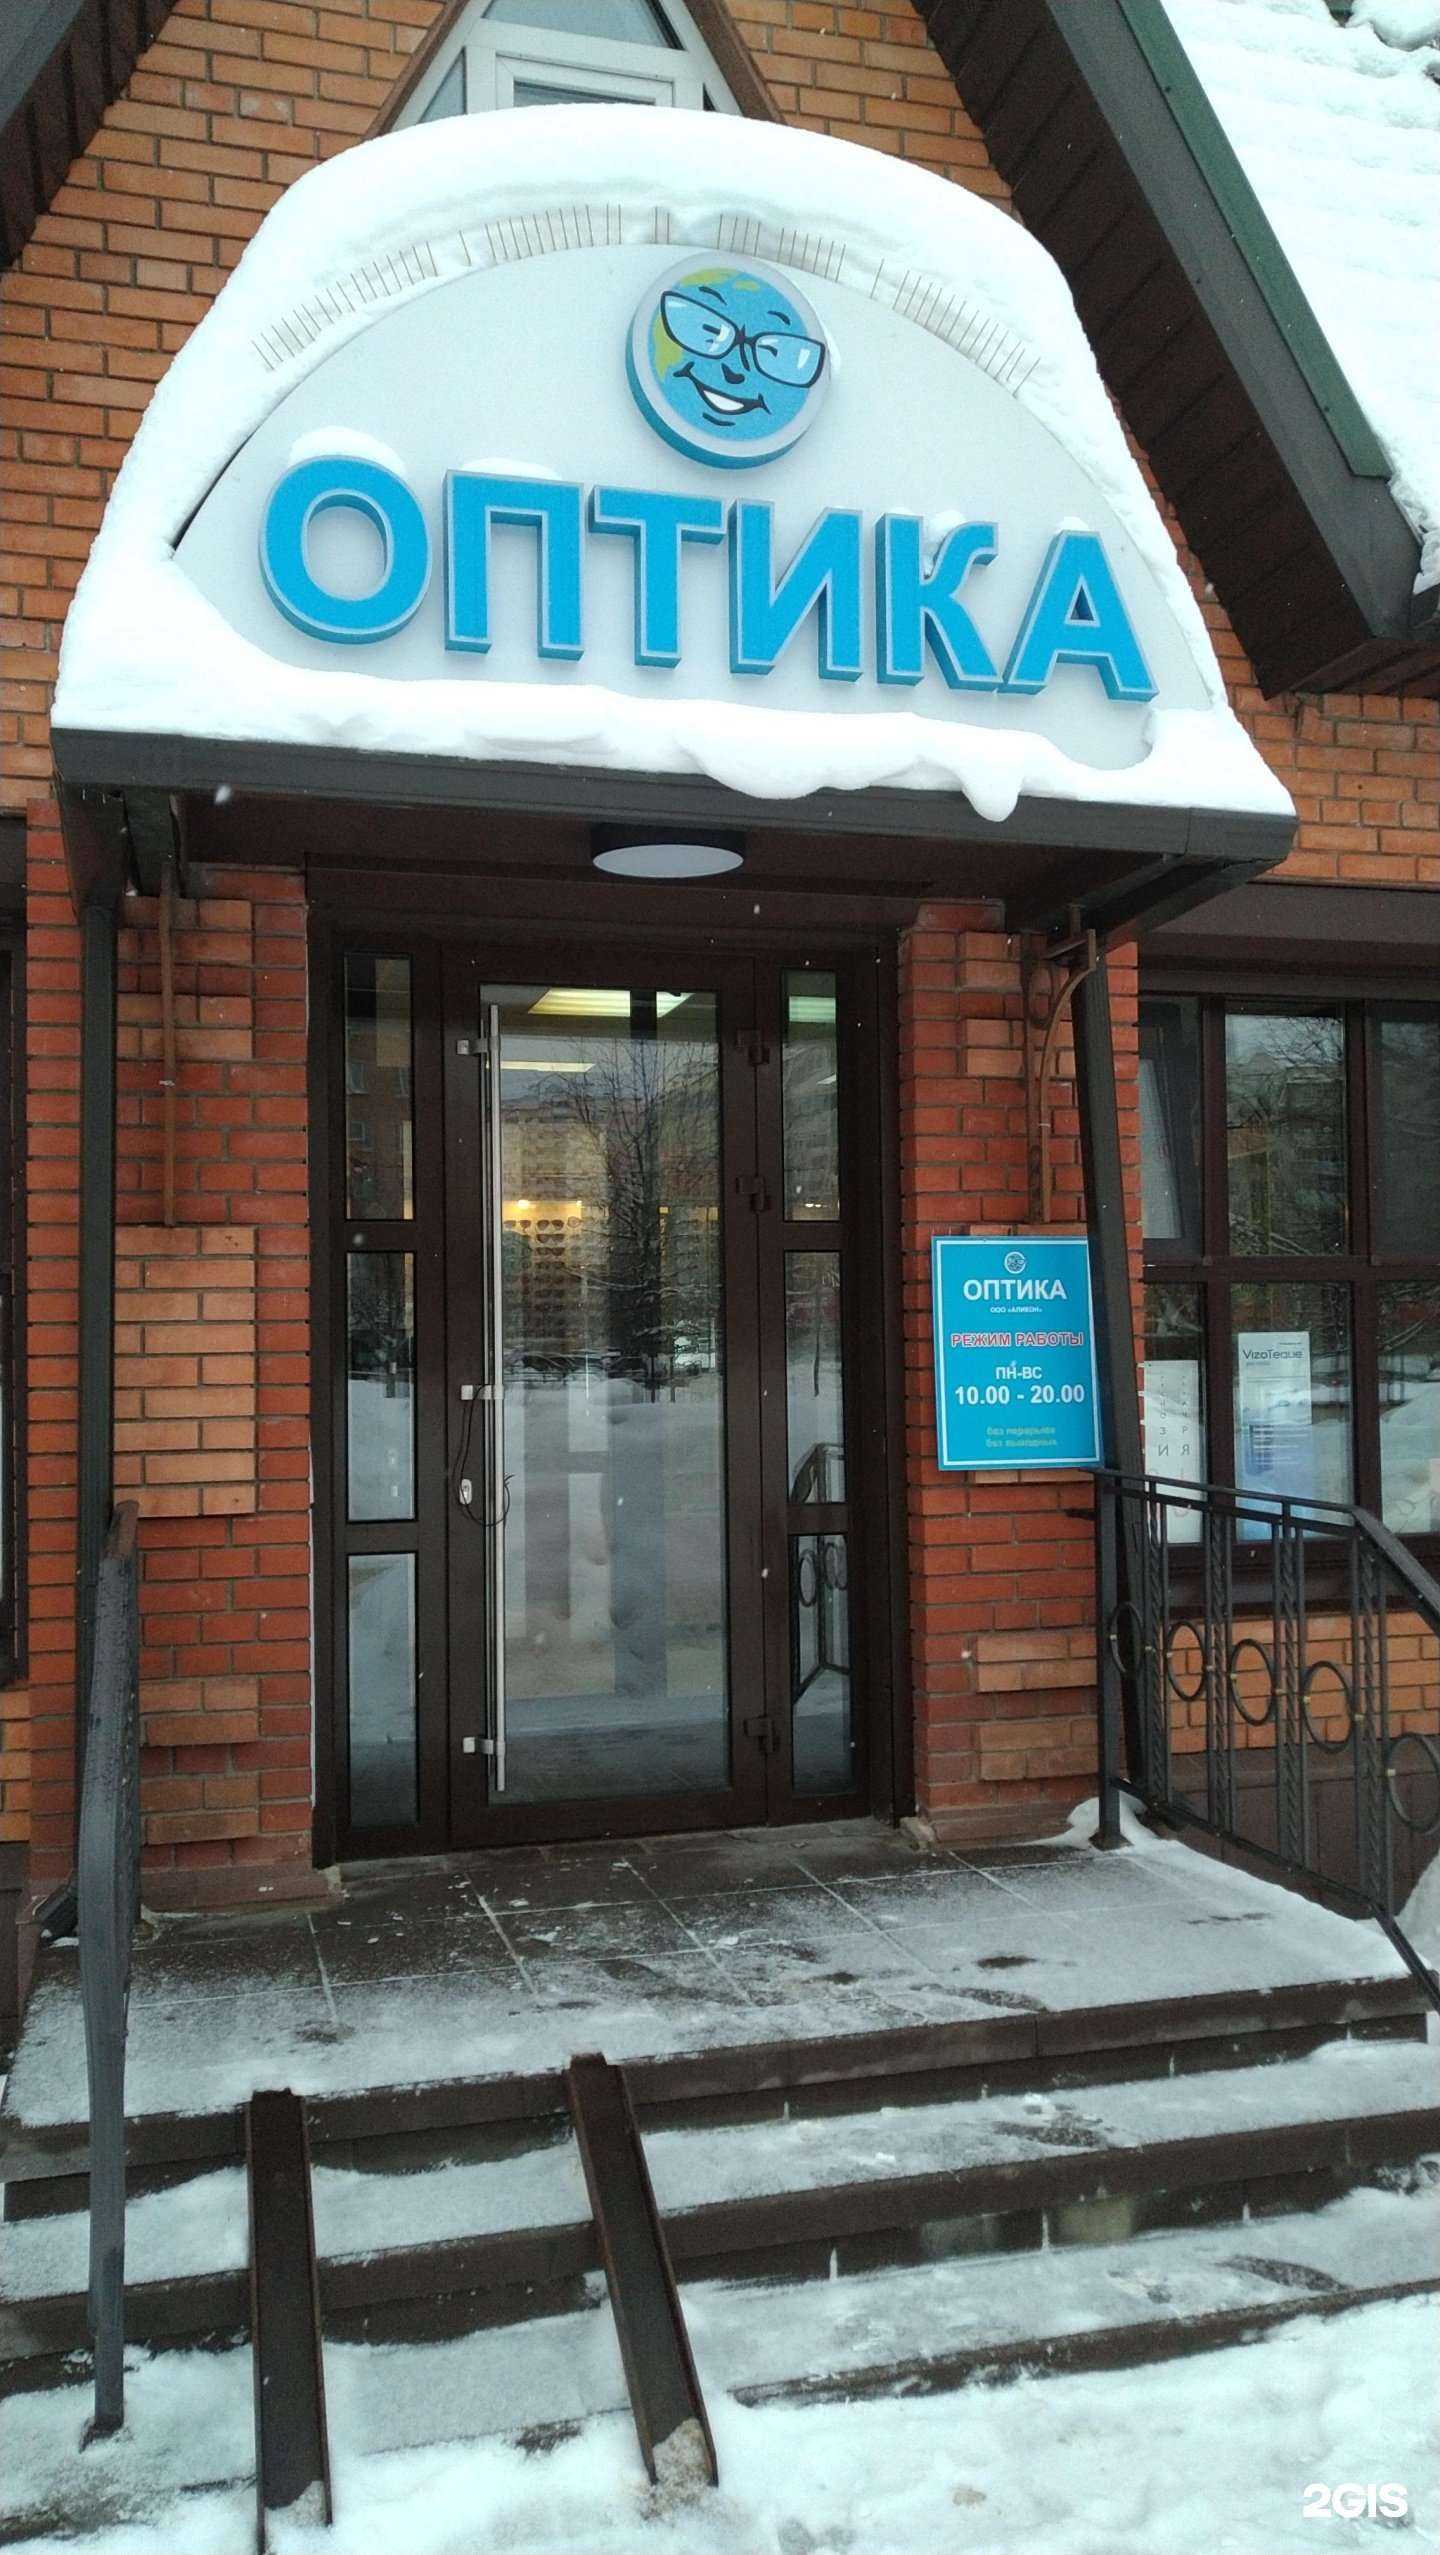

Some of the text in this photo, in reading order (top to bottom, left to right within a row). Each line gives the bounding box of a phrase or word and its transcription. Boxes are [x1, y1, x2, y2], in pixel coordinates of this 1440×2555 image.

[259, 454, 1158, 702] ОПТИКА
[963, 1279, 1067, 1301] ОПТИКА
[951, 1331, 1084, 1347] РЕЖИМ РАБОТЫ
[995, 1366, 1042, 1380] ПН-ВС
[955, 1386, 1010, 1405] 10.00
[1030, 1384, 1085, 1404] 20.00
